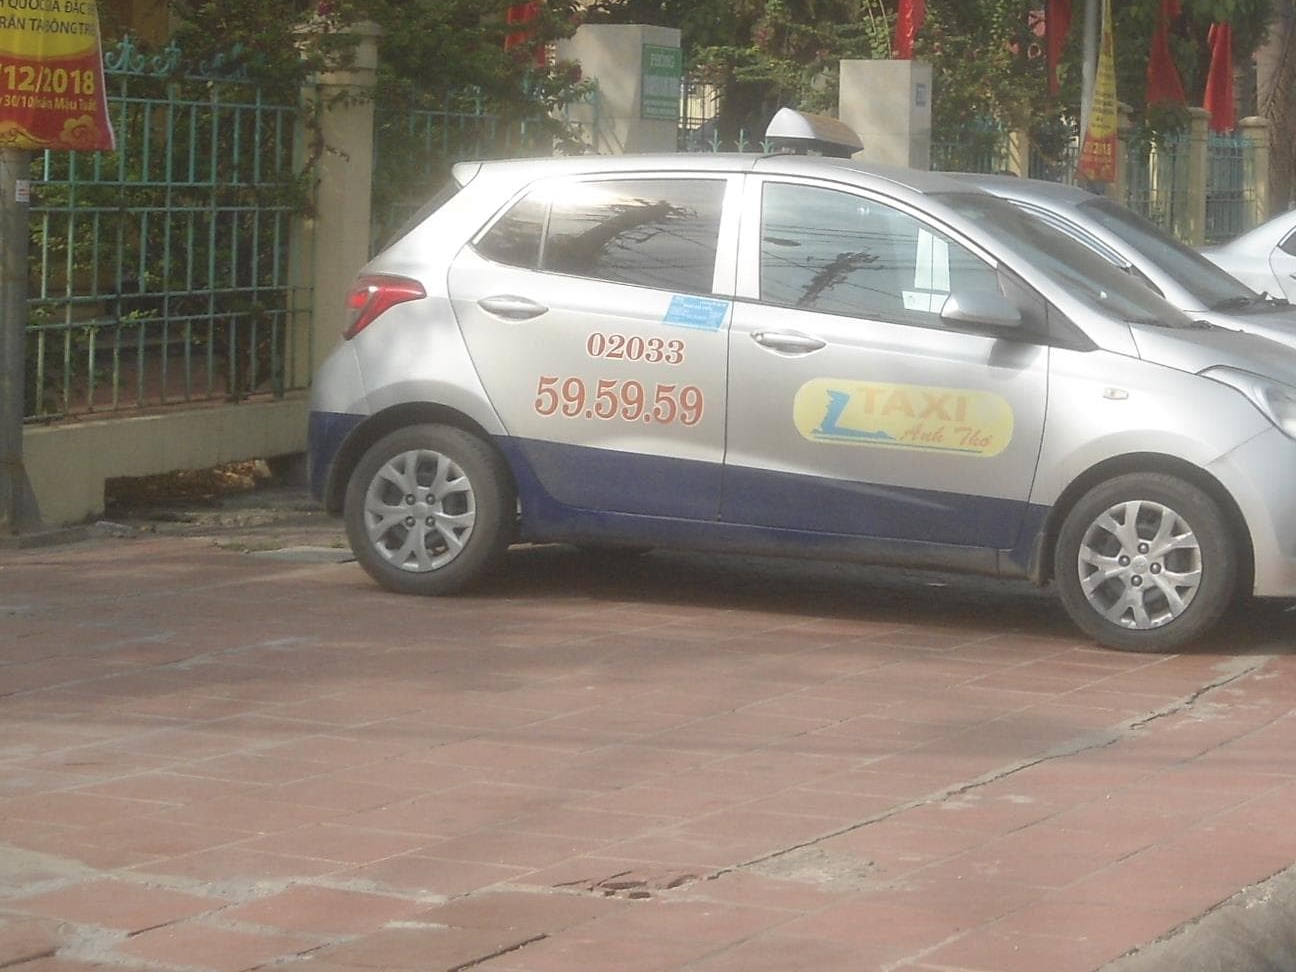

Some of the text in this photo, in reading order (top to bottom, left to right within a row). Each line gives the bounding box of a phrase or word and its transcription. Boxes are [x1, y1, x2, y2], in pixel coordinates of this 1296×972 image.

[586, 331, 686, 366] 02033
[533, 375, 705, 427] 59.59.59
[855, 386, 969, 423] TAXI
